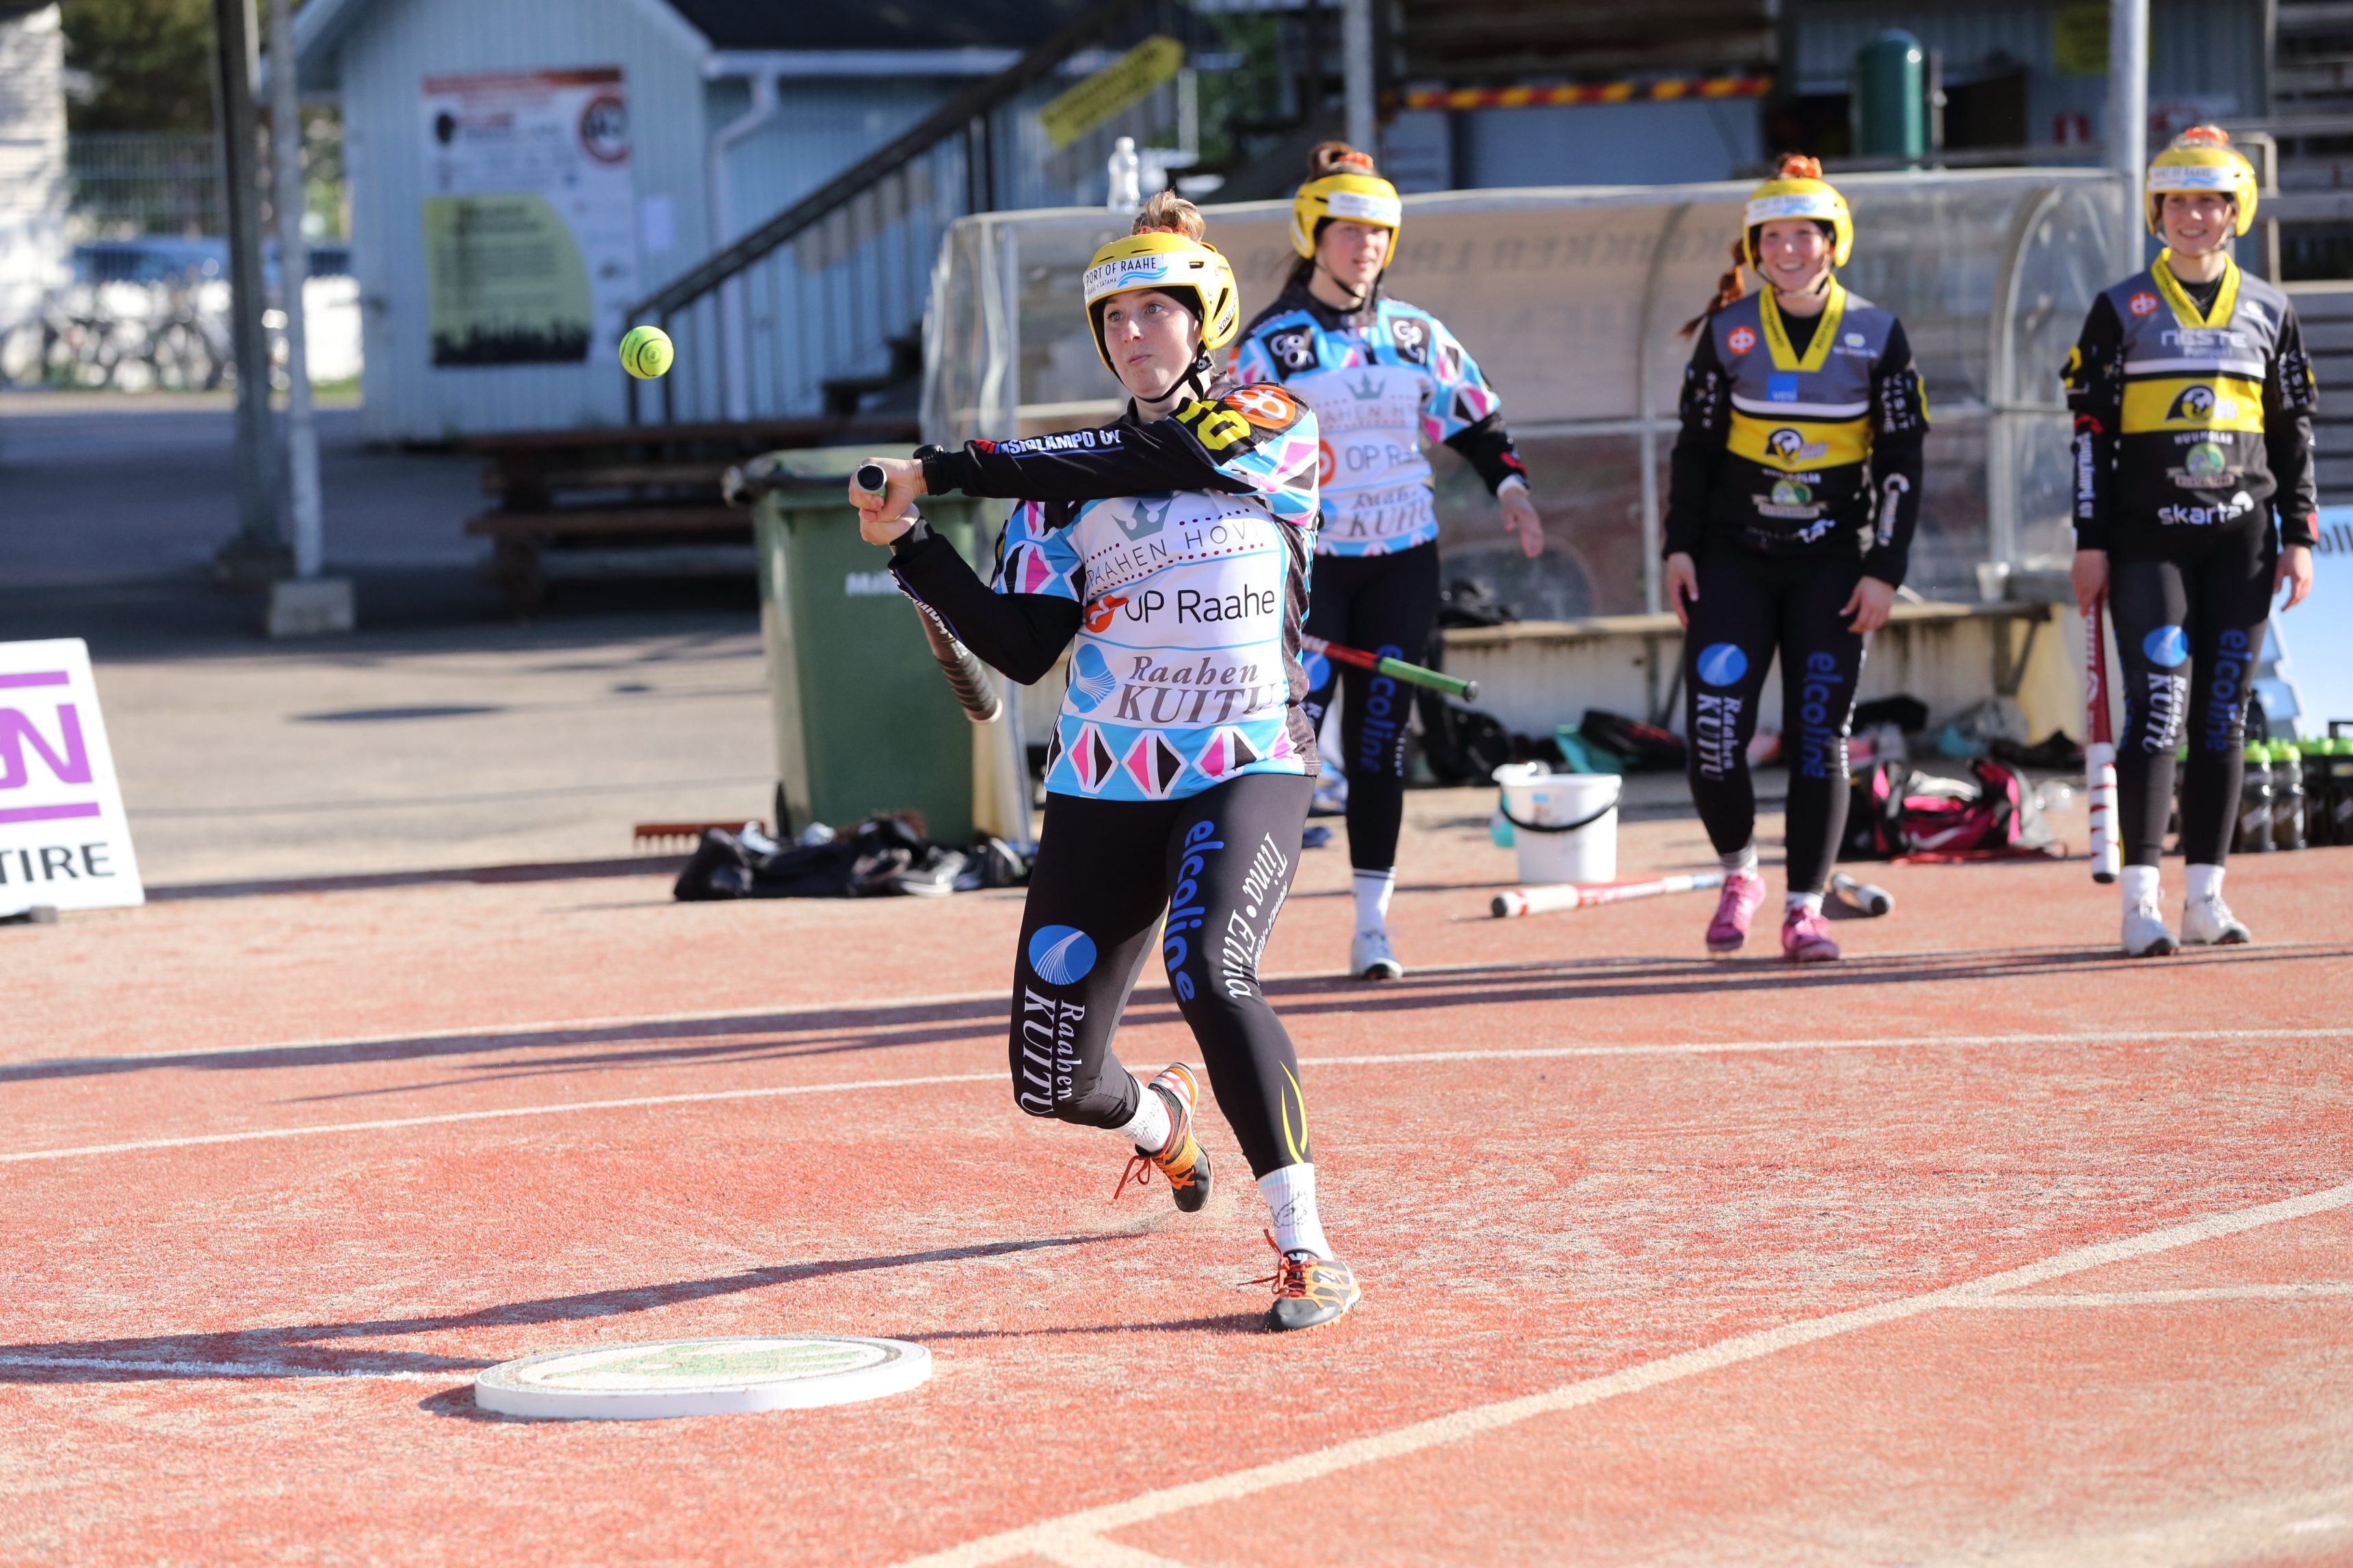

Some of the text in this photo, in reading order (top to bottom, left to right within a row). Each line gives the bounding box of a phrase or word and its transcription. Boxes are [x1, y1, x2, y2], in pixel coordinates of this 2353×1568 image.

[1086, 257, 1157, 285] PORT OF RAAHE
[1100, 278, 1117, 287] SATAMA
[1178, 584, 1275, 624] Raahe
[1114, 682, 1277, 724] KUITU
[1129, 656, 1259, 685] Raahen
[1360, 644, 1404, 773] ecoline
[1696, 692, 1724, 782] KUITU
[1164, 821, 1224, 1003] elcoline
[1020, 984, 1057, 1115] KUITU
[1056, 1000, 1086, 1101] Raahen
